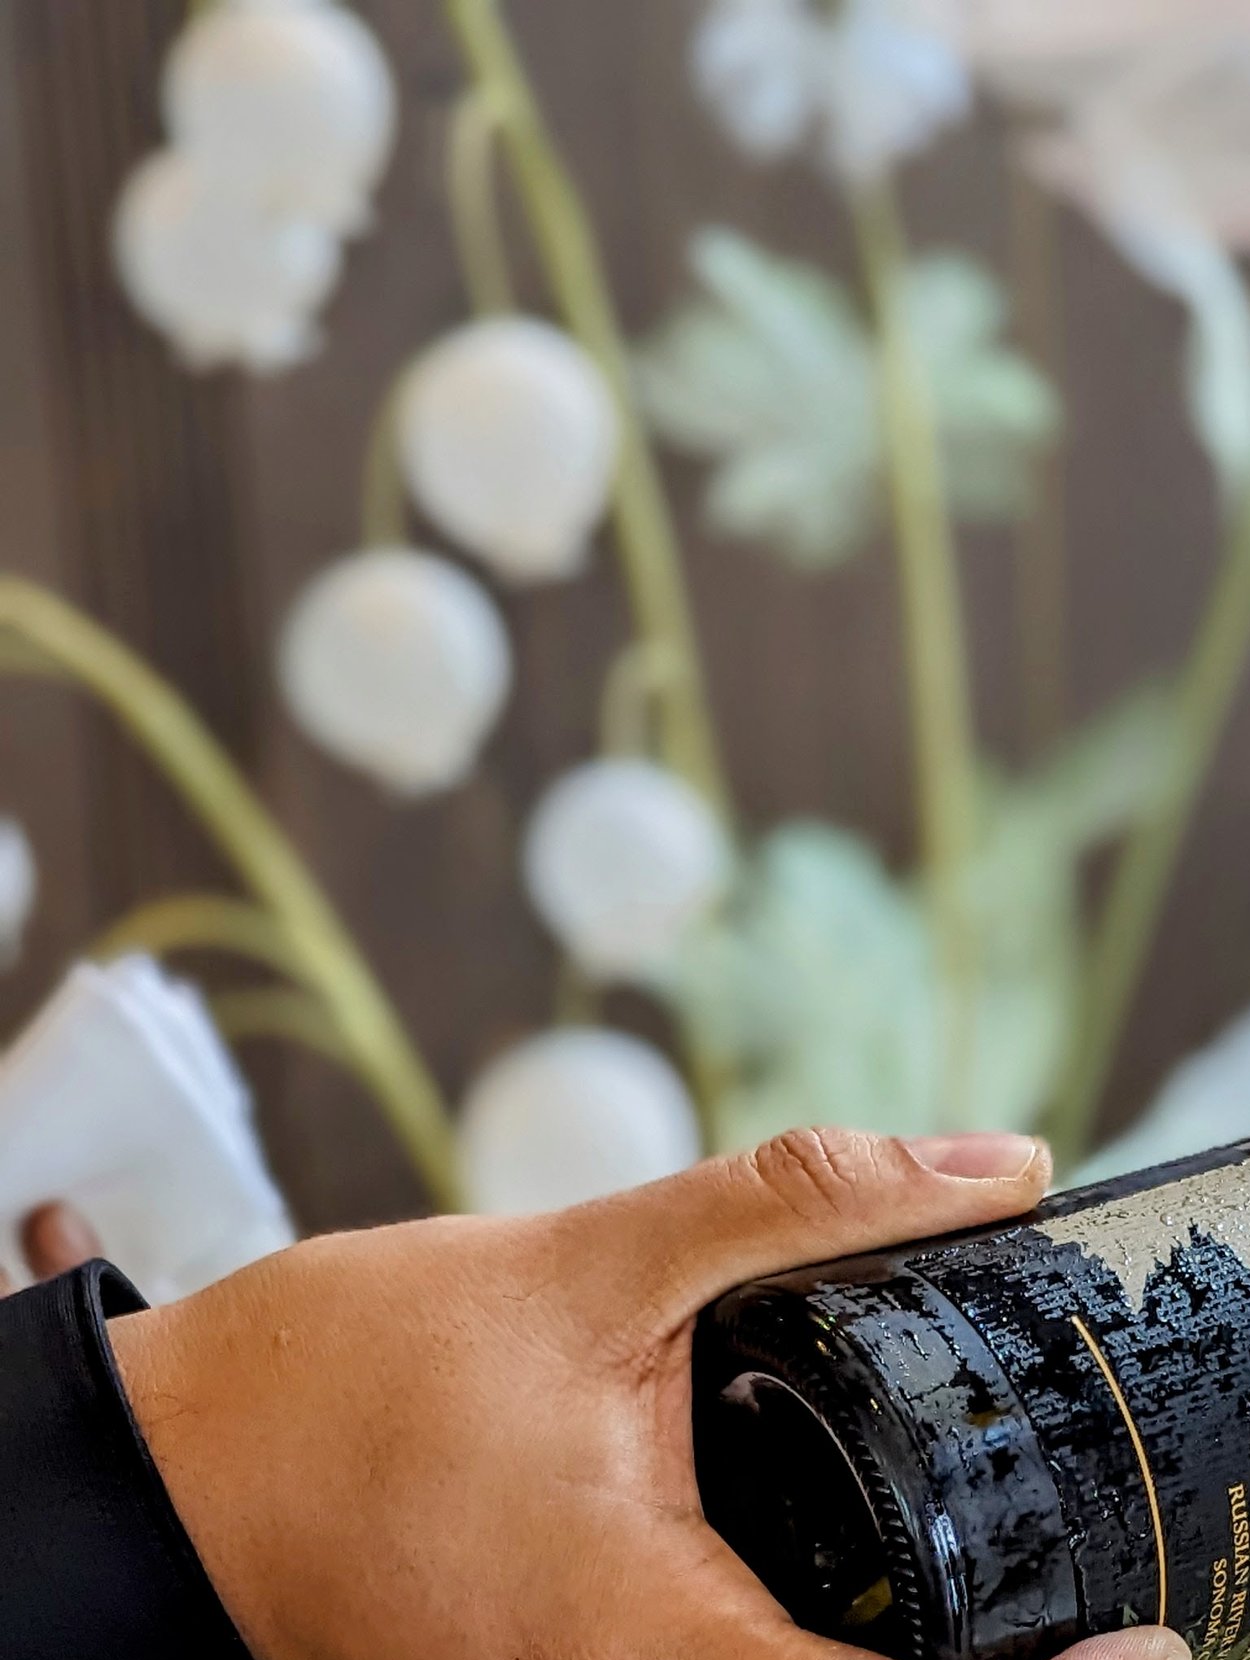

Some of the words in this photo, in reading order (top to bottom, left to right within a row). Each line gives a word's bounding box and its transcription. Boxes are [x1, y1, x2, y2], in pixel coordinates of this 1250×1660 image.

[1227, 1482, 1250, 1586] RUSSIAN
[1202, 1557, 1228, 1648] SONOMA
[1219, 1590, 1247, 1650] RIVER
